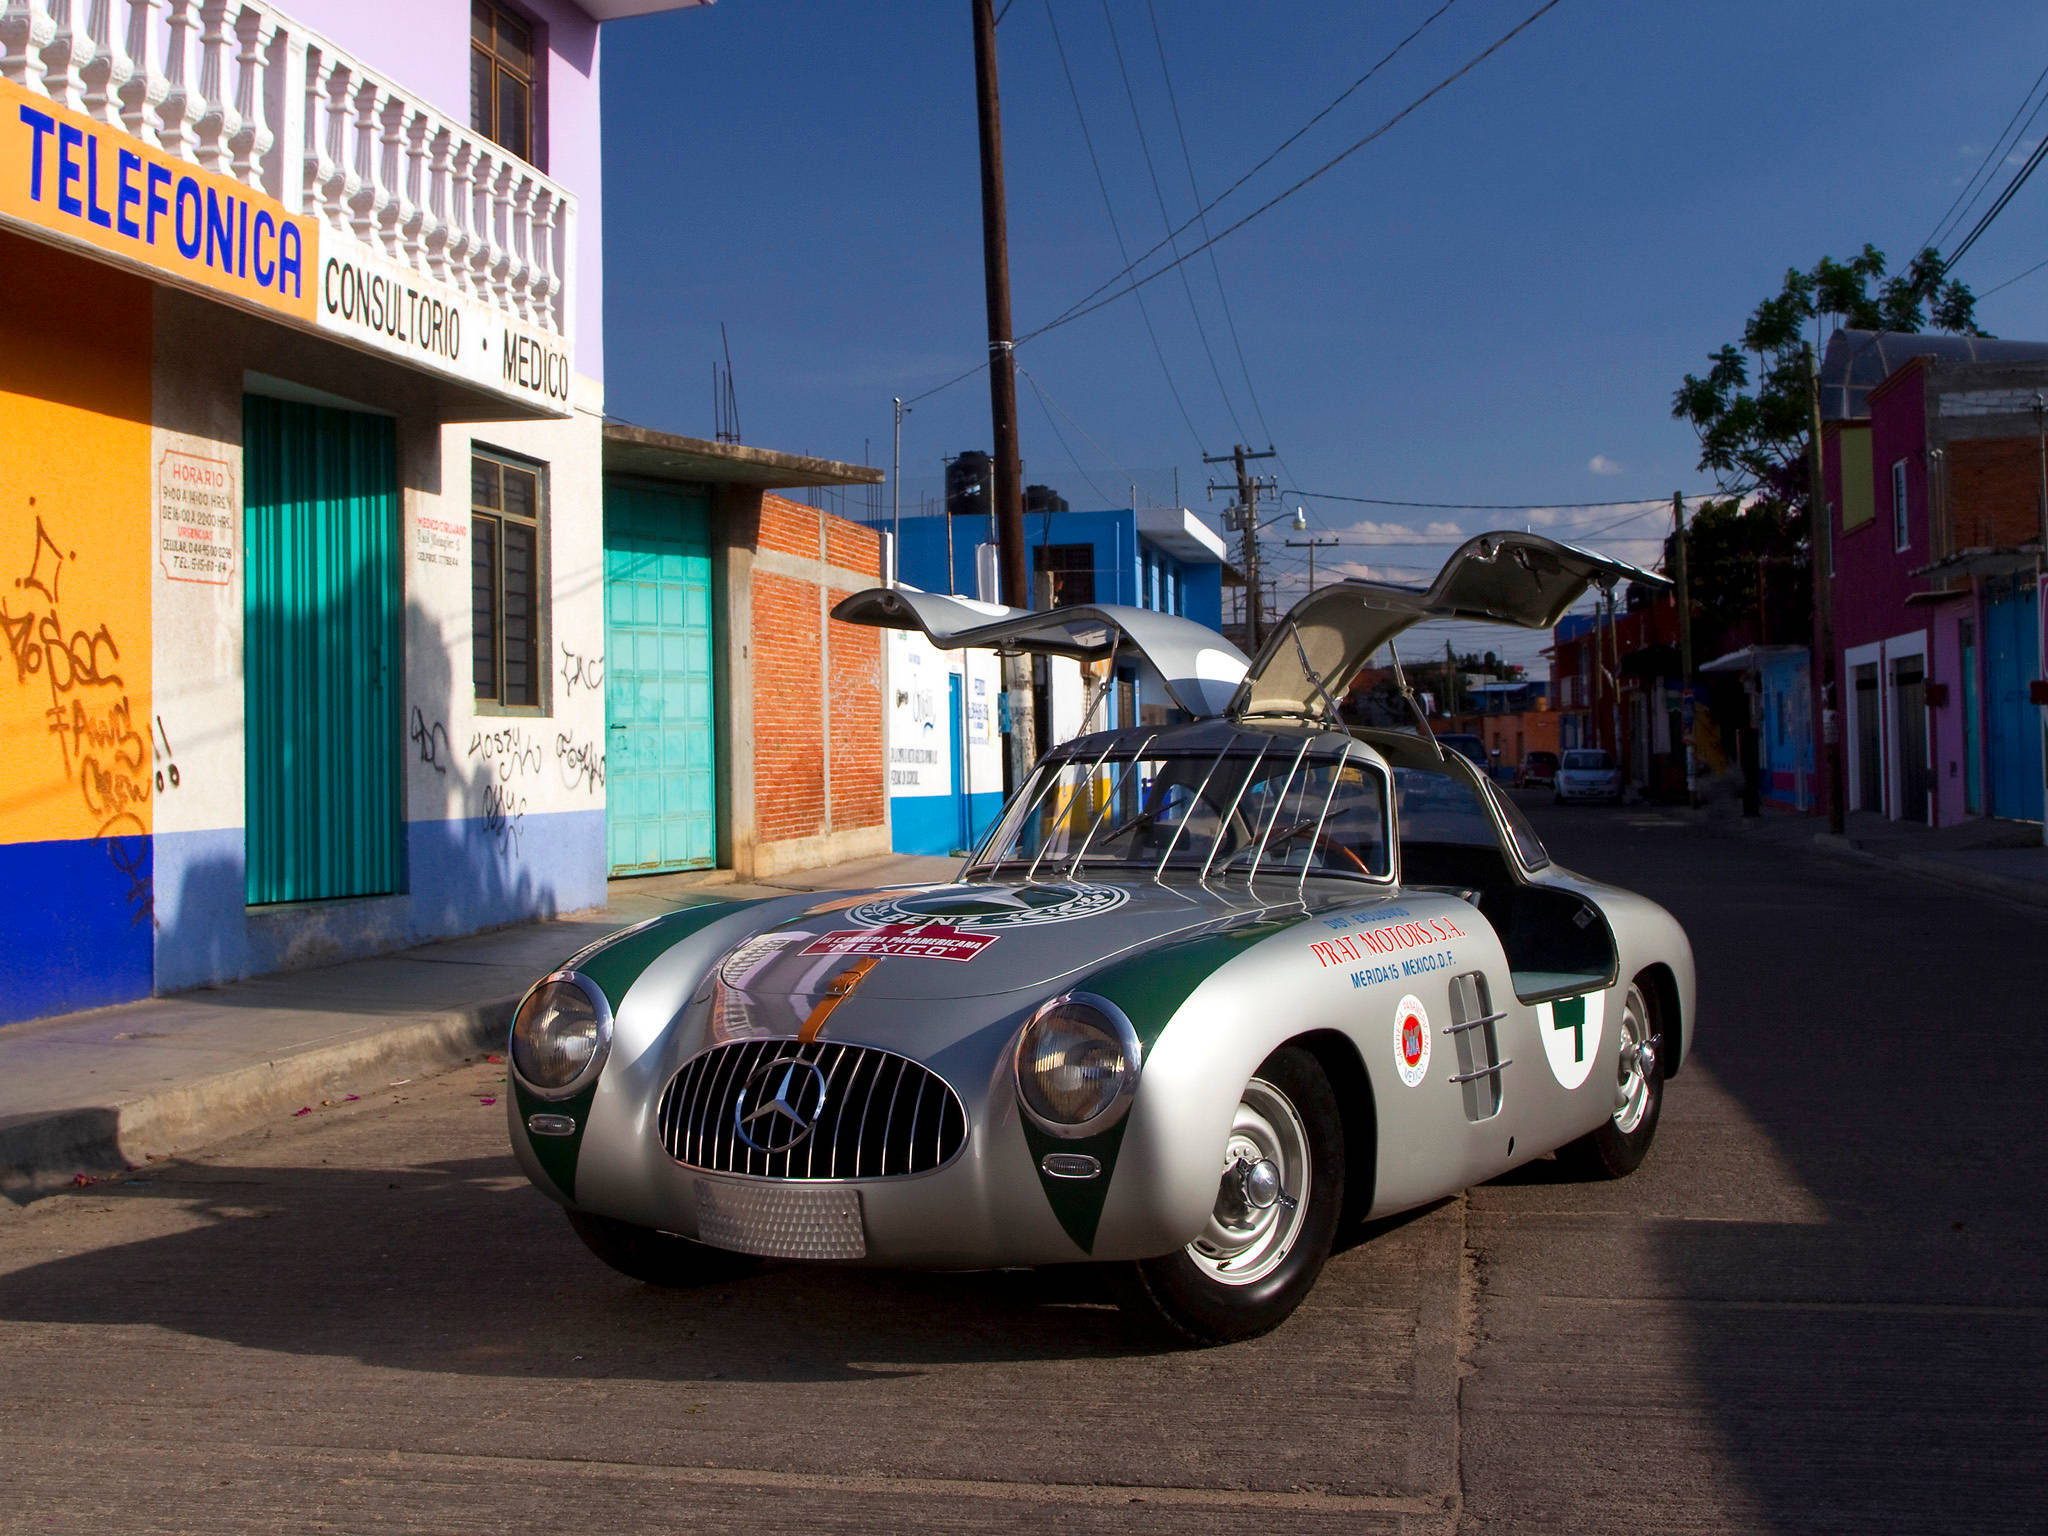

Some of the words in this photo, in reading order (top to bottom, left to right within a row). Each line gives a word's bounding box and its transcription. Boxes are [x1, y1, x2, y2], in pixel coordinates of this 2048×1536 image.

[19, 104, 302, 299] TELEFONICA
[325, 257, 460, 360] CONSULTORIO
[503, 328, 568, 401] MEDICO
[173, 463, 225, 488] HORARIO
[162, 505, 173, 520] DE
[878, 913, 982, 926] BENZ
[902, 924, 923, 936] 4
[886, 936, 982, 949] PANAMERICANA
[1309, 935, 1361, 968] PRAT
